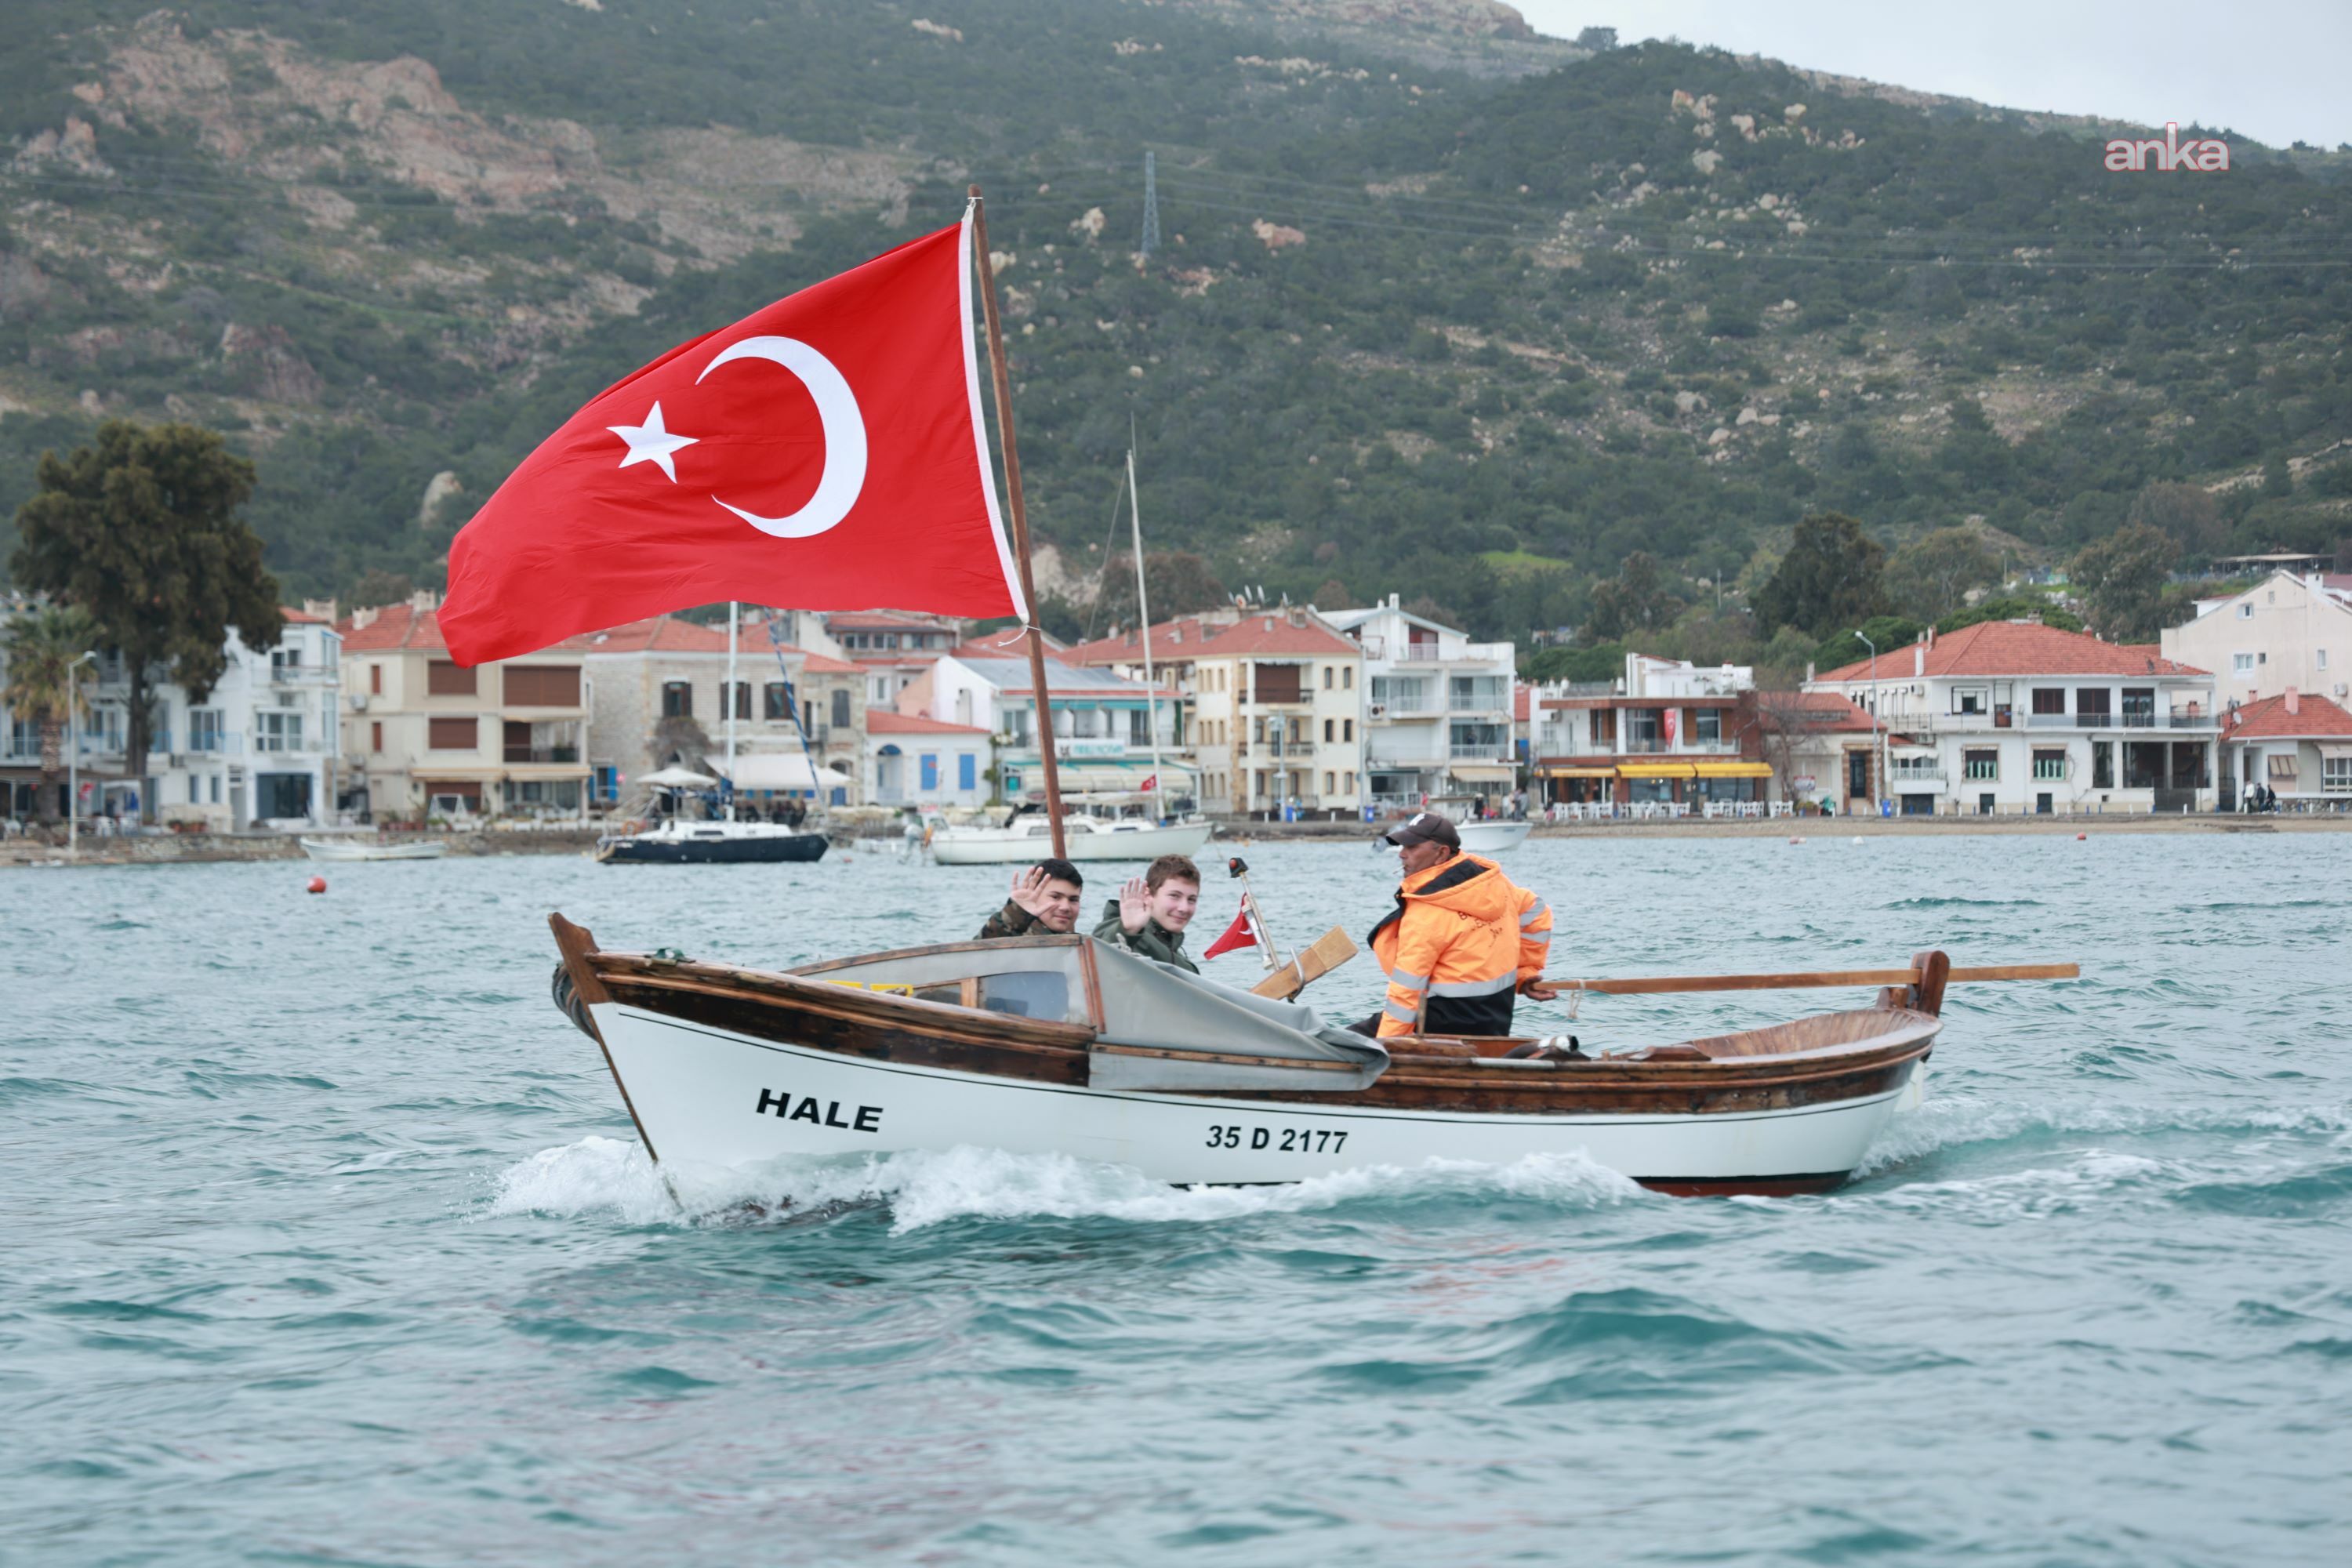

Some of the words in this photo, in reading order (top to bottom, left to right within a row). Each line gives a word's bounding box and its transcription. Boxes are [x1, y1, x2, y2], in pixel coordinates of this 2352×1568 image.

[756, 1087, 884, 1133] HALE
[1206, 1125, 1241, 1149] 35
[1250, 1127, 1270, 1150] D
[1279, 1128, 1348, 1154] 2177
